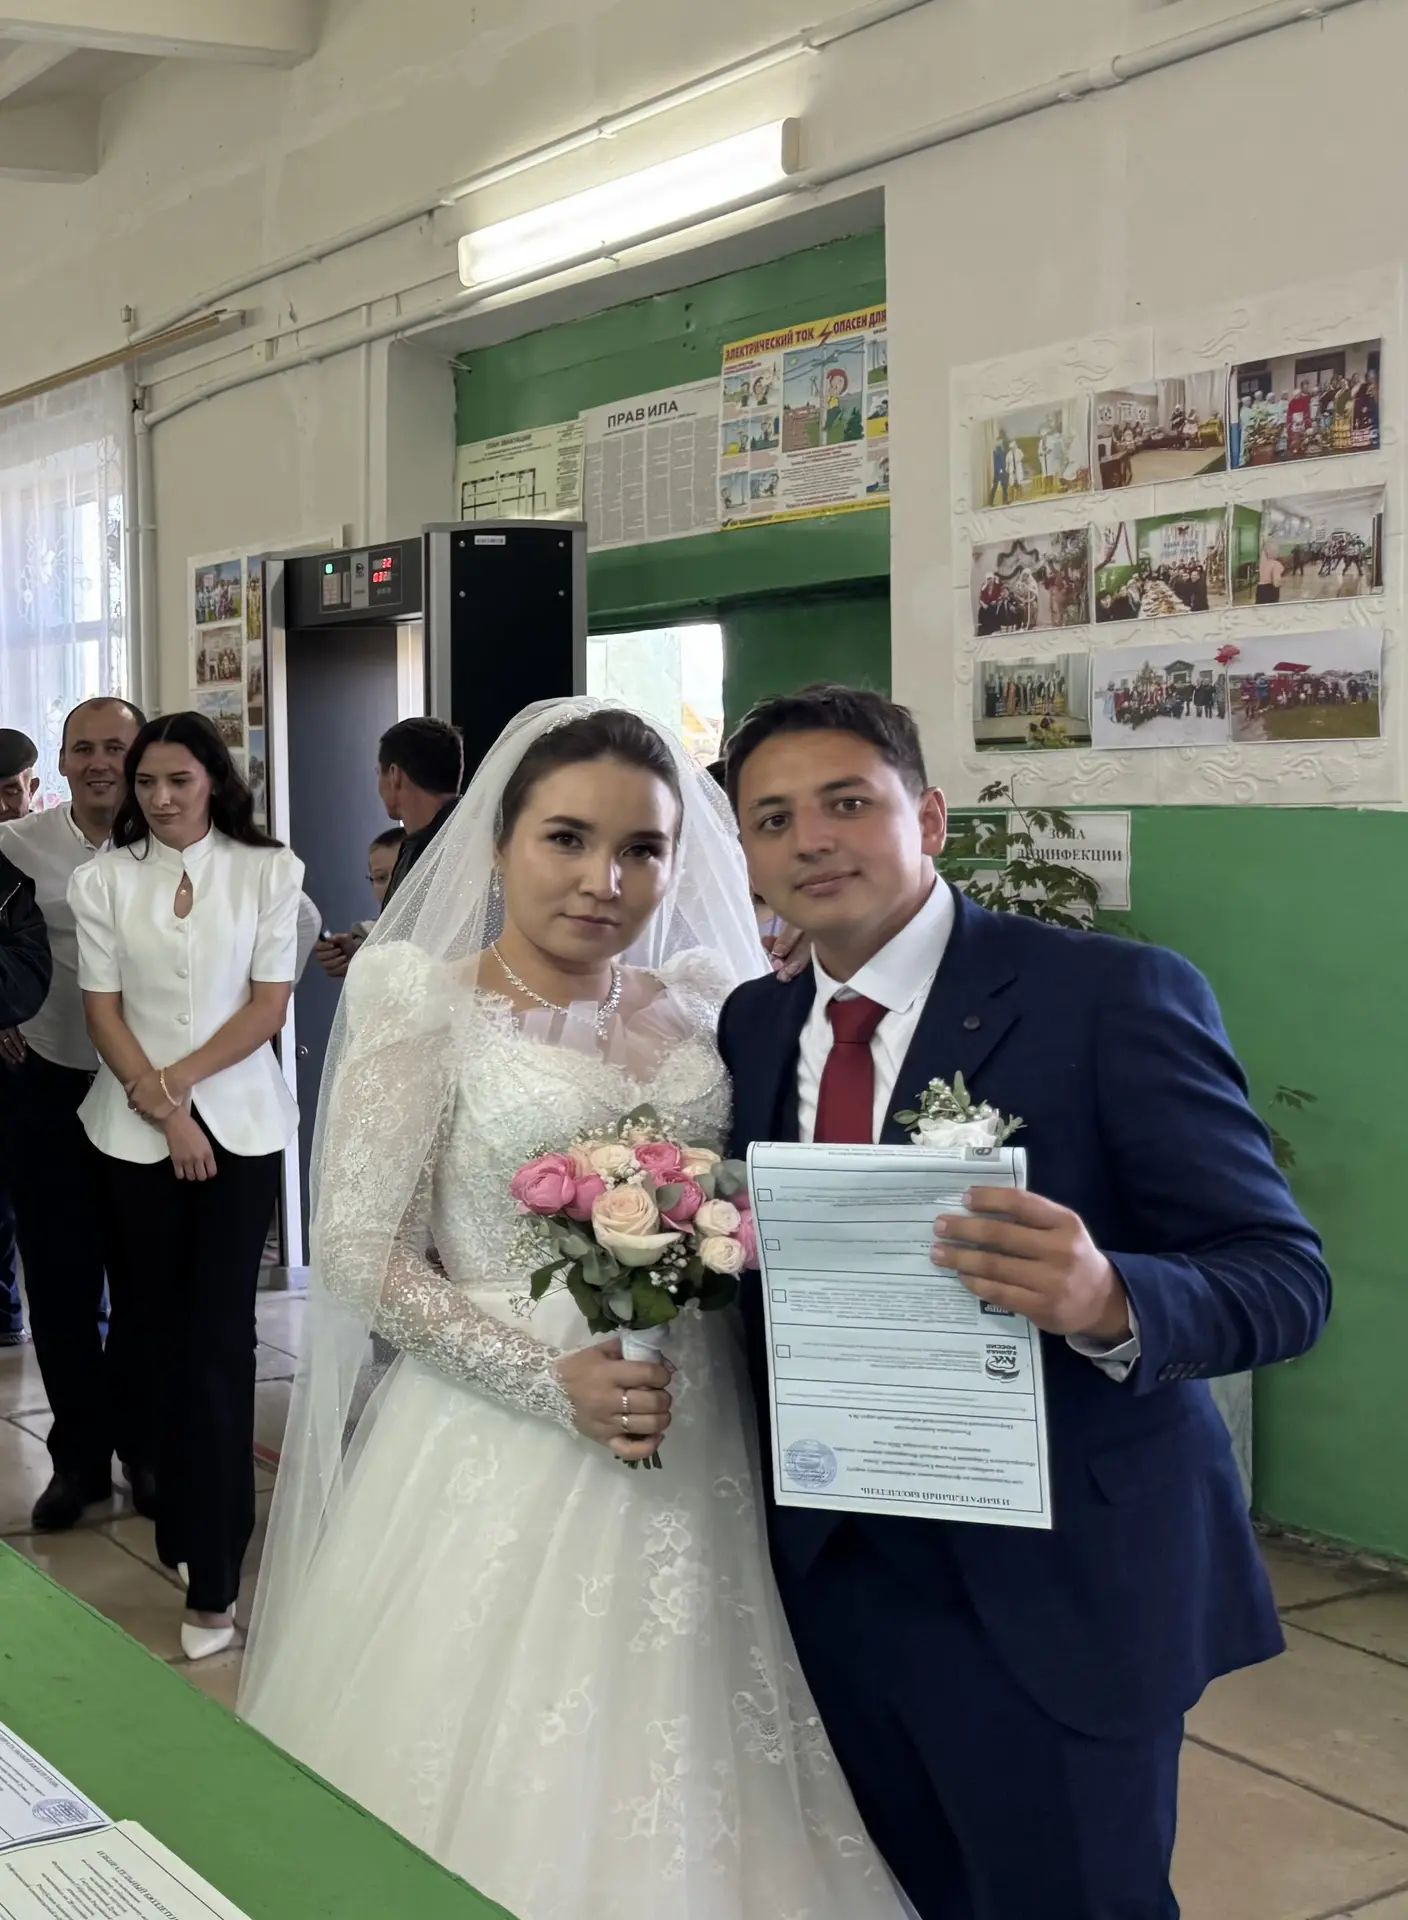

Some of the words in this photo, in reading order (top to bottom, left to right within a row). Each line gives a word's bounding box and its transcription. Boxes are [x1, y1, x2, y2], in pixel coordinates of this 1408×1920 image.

[725, 330, 794, 362] ЭЛЕКТРИЧЕСКИЙ
[796, 327, 815, 342] ТОК
[833, 313, 868, 334] ОПАСЕН
[607, 400, 678, 429] ПРАВИЛА
